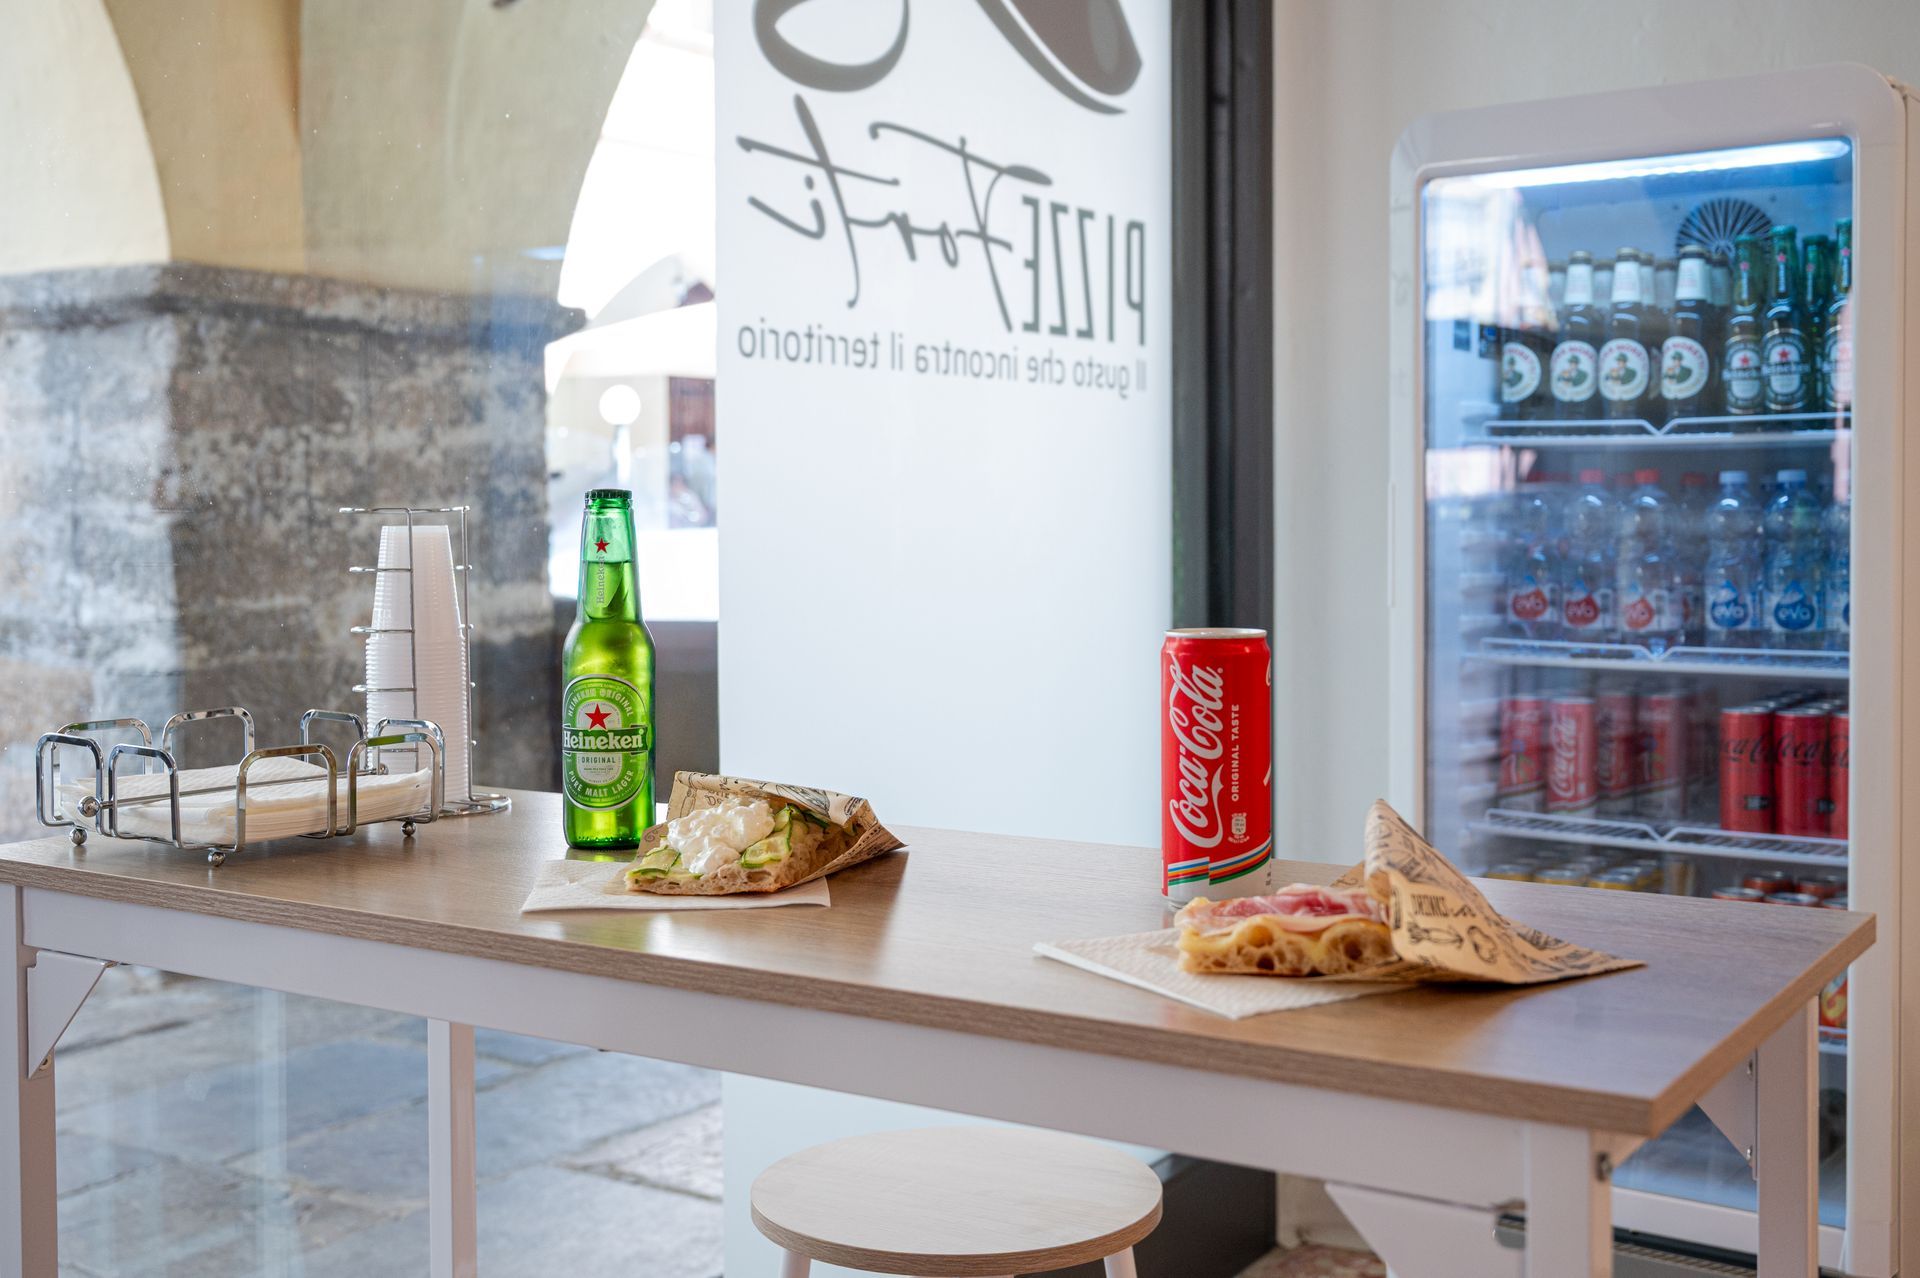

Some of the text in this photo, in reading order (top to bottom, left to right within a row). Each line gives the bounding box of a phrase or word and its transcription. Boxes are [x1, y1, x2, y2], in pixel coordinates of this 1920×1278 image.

[600, 688, 634, 717] ORIGINAL
[563, 730, 643, 750] Heineken
[1169, 653, 1224, 848] Coca-Cola
[1231, 704, 1240, 802] ORIGINAL TASTE
[581, 756, 616, 764] ORIGINAL
[568, 770, 583, 792] PURE
[585, 787, 609, 797] MALT
[611, 770, 634, 795] LAGER
